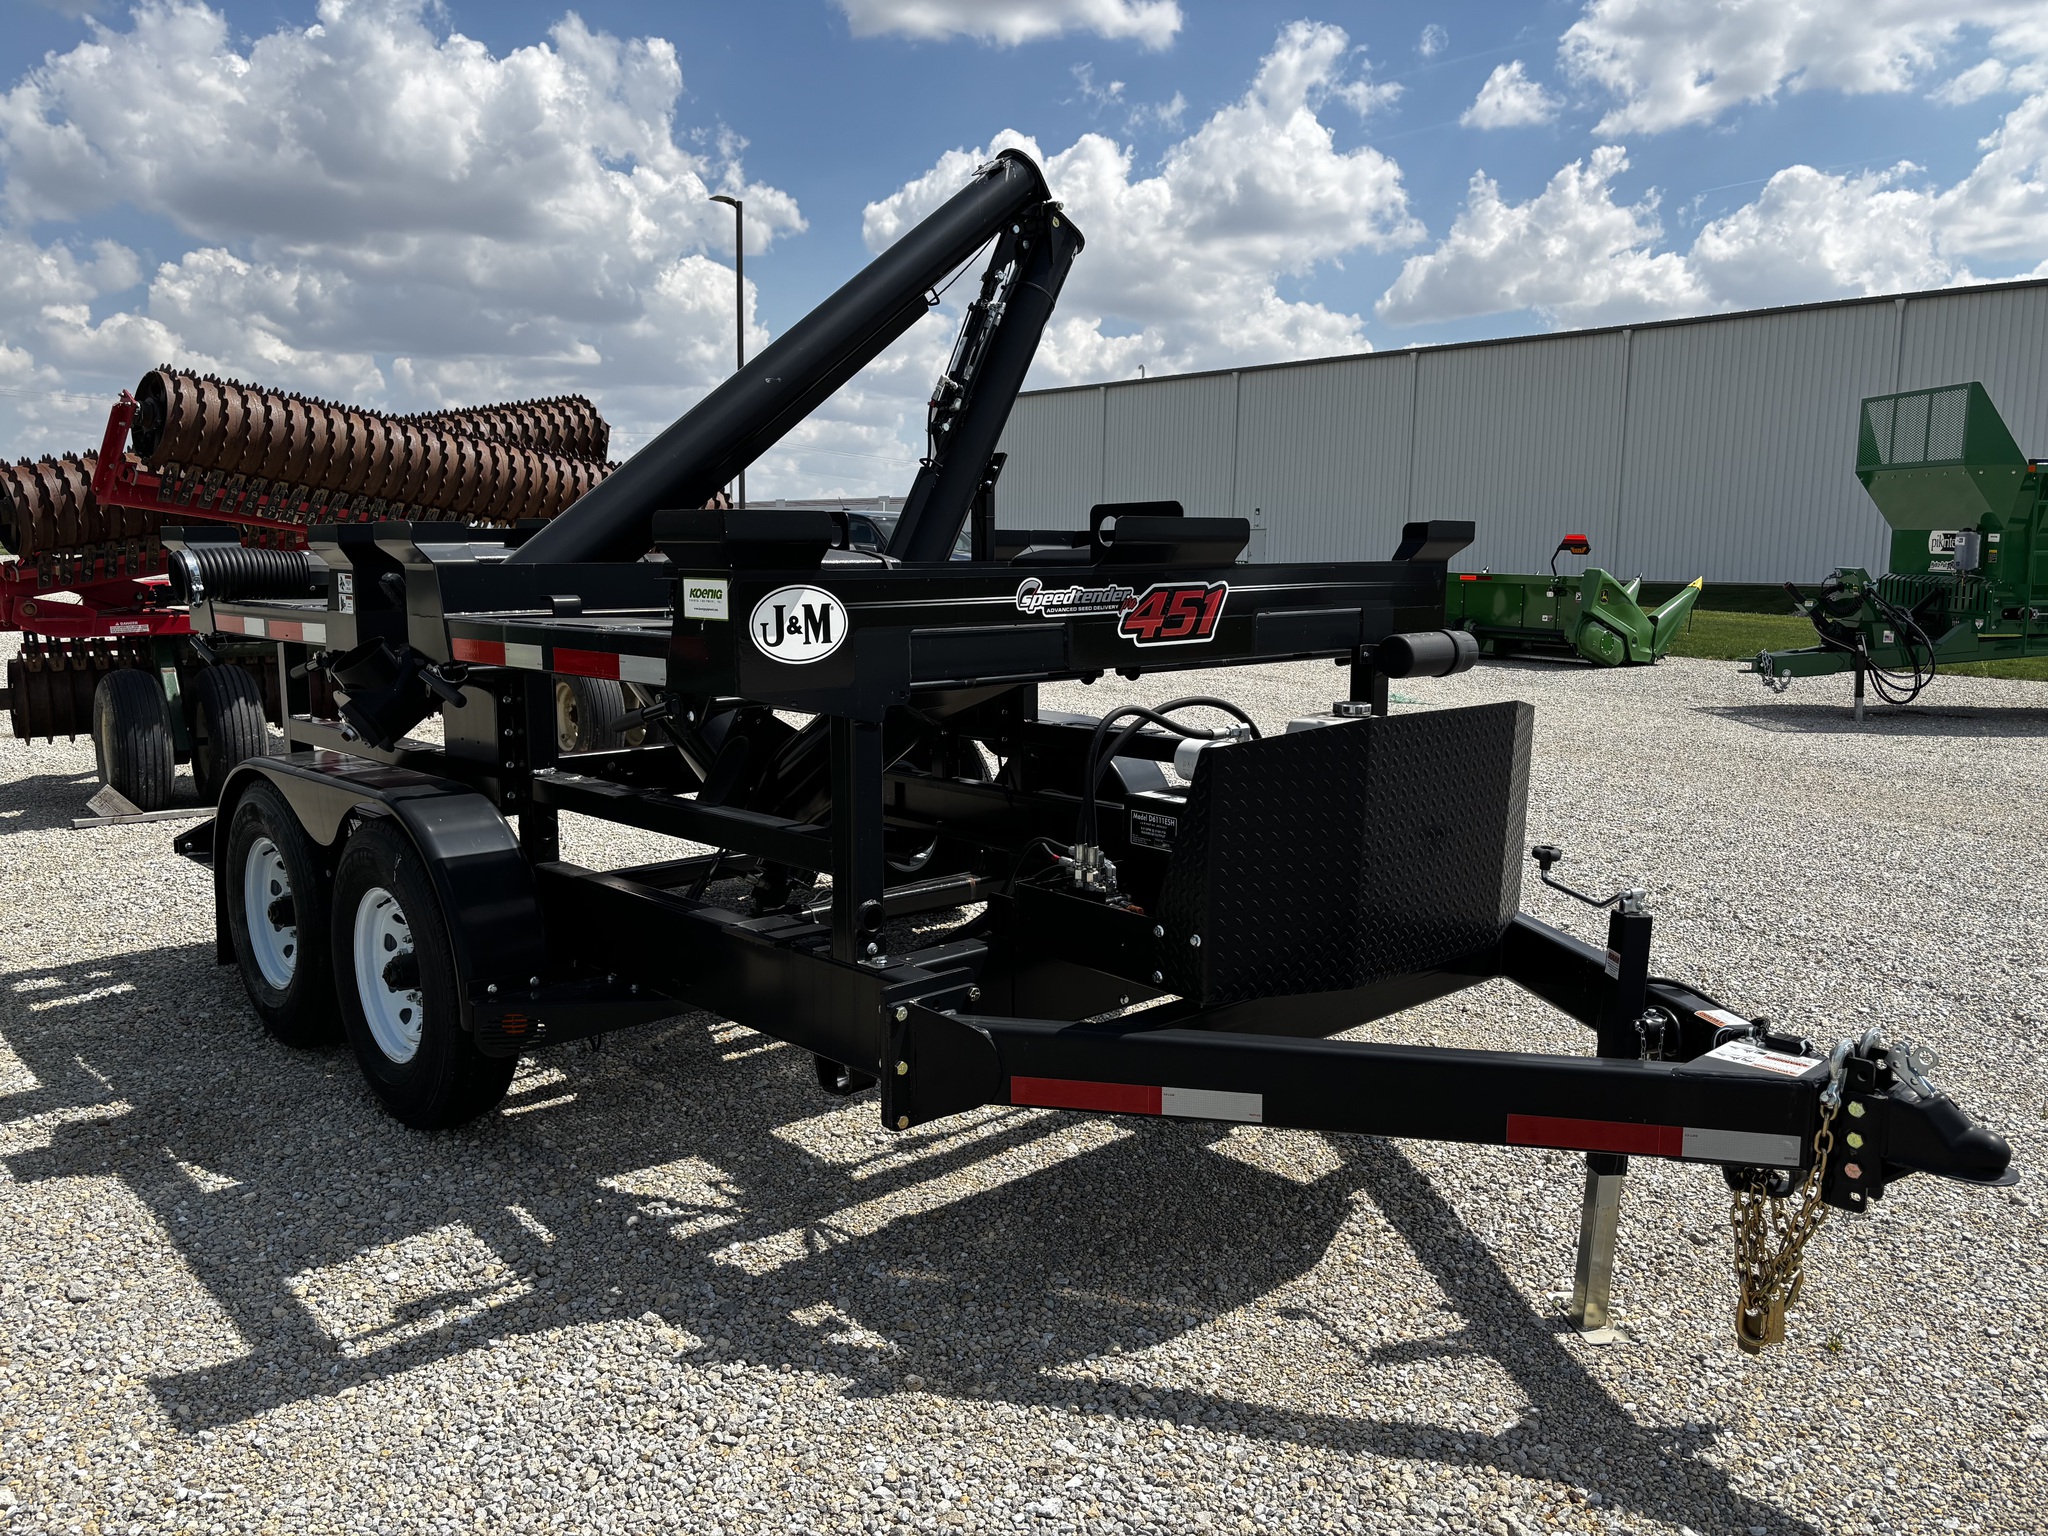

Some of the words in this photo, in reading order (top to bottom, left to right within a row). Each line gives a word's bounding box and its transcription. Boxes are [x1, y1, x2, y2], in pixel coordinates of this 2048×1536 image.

[760, 603, 833, 648] J&M
[1124, 589, 1224, 638] 451
[1133, 812, 1148, 821] Model
[1149, 815, 1175, 826] D6111ESH
